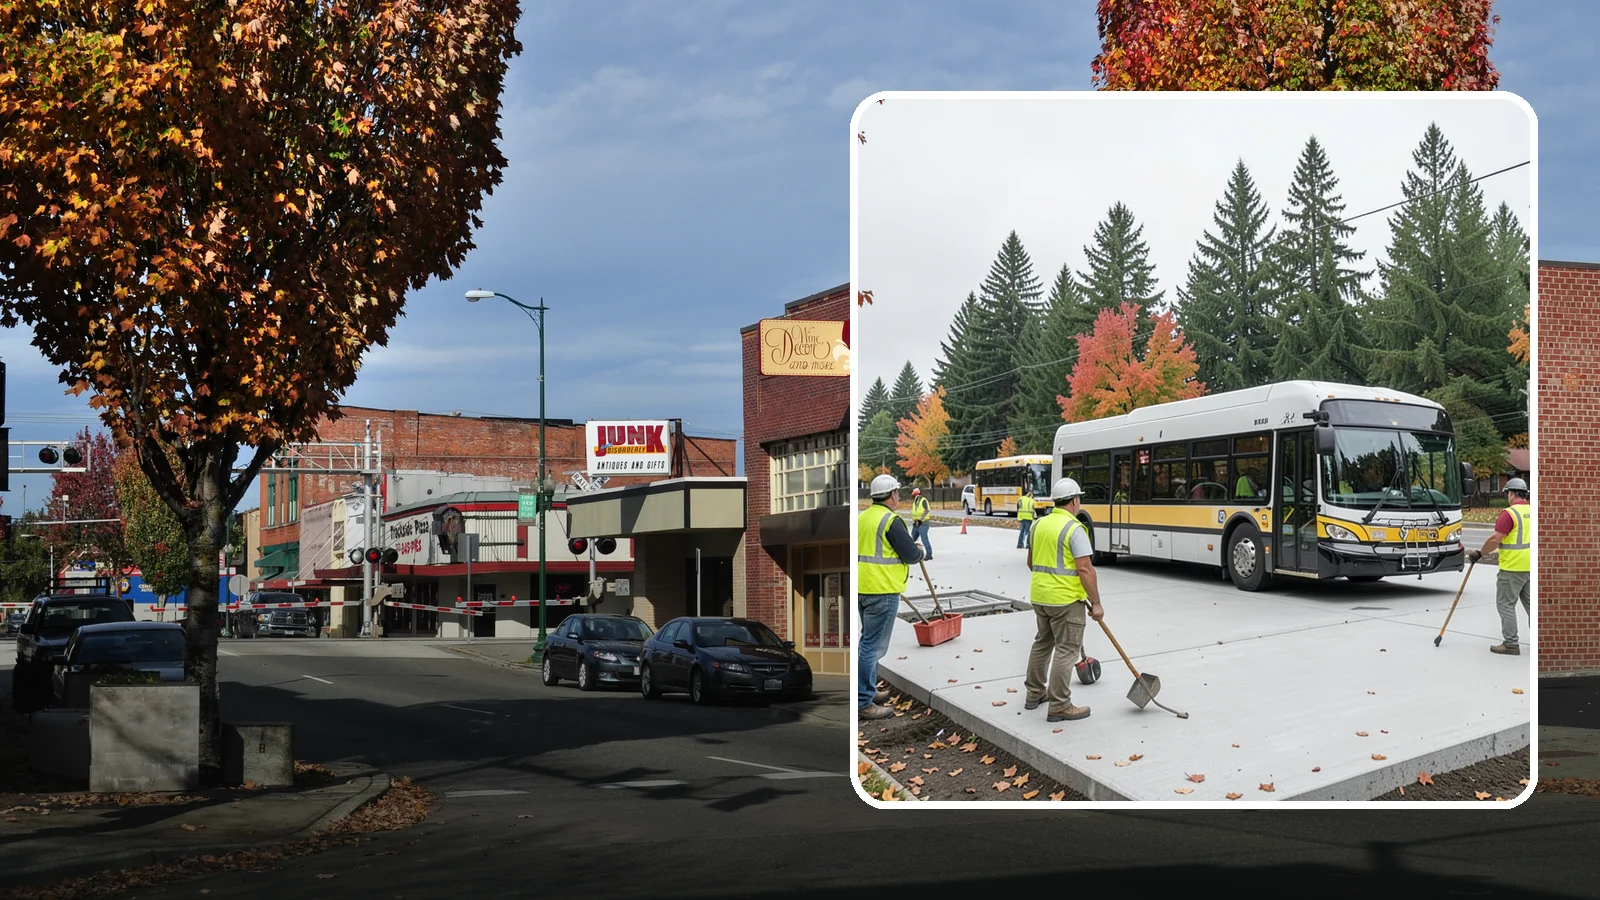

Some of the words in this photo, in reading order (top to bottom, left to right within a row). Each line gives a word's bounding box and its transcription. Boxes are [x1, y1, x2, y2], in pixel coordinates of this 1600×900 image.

[595, 425, 665, 457] JUNK
[597, 461, 628, 470] ANTIQUES
[631, 461, 644, 470] AND
[647, 461, 665, 469] GIFTS
[573, 473, 589, 492] RAIL
[414, 519, 429, 534] Pizza
